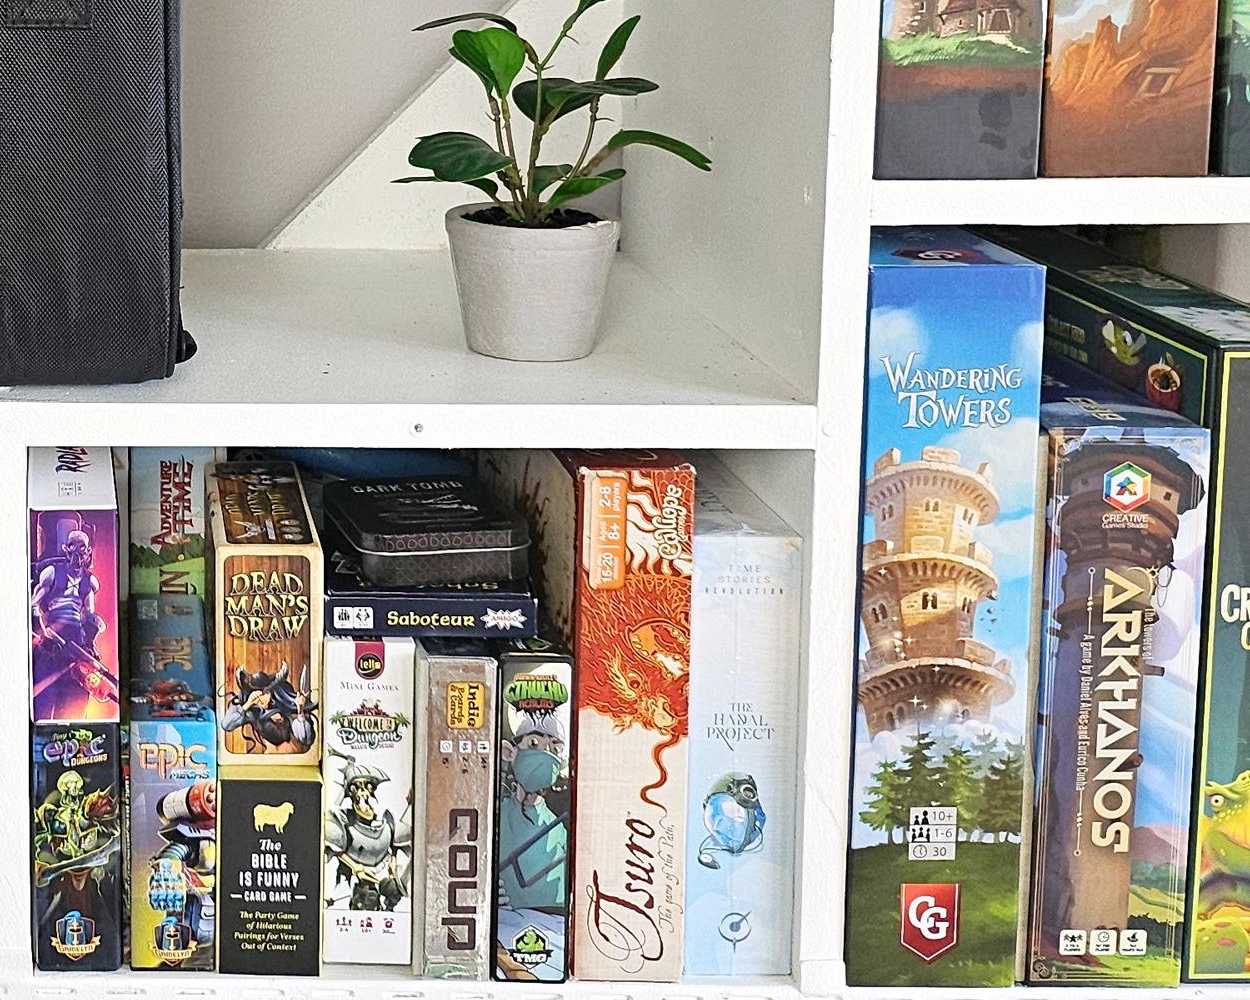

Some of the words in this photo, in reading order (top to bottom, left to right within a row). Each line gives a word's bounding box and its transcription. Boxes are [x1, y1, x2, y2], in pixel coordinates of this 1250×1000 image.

[881, 351, 1022, 394] WANDERING
[897, 390, 1012, 429] TOWERS
[351, 483, 402, 493] DARK
[406, 481, 463, 490] TOMB
[151, 460, 173, 550] ADVENTURE
[172, 460, 194, 533] TIME
[599, 487, 611, 507] 2-8
[613, 482, 621, 512] players
[651, 485, 682, 560] Calliope
[1102, 513, 1149, 523] CREATIVE
[1102, 521, 1125, 529] Games
[1126, 521, 1148, 529] Studio
[608, 523, 620, 540] 8+
[229, 571, 303, 596] DEAD
[718, 576, 771, 584] STORIES
[225, 594, 308, 618] MAN'S
[229, 614, 308, 642] DRAW
[387, 610, 475, 630] Saboteur
[1080, 642, 1092, 663] game
[1079, 665, 1093, 676] by
[367, 682, 398, 691] GAMES
[508, 680, 565, 701] CTHULHU
[1080, 677, 1093, 701] Daniel
[468, 684, 479, 727] Indie
[730, 703, 753, 712] THE
[1078, 702, 1092, 723] Alves
[1091, 567, 1145, 853] ARKHANOS
[337, 728, 402, 749] Dungeon
[707, 727, 774, 751] PROJECT
[71, 754, 108, 767] DUNGEONS
[932, 811, 953, 822] 10+
[934, 828, 952, 839] 1-6
[259, 839, 281, 851] The
[932, 846, 947, 857] 30
[251, 854, 287, 869] BIBLE
[239, 871, 252, 887] IS
[257, 872, 299, 888] FUNNY
[244, 891, 266, 902] CARD
[269, 891, 291, 902] GAME
[586, 818, 663, 973] Tsuro
[239, 911, 253, 919] The
[255, 911, 275, 920] Party
[277, 912, 299, 920] Game
[256, 922, 291, 930] Hilarious
[234, 932, 265, 941] Pairings
[266, 932, 278, 941] for
[280, 932, 304, 940] Verses
[241, 942, 255, 950] Out
[257, 942, 265, 951] of
[267, 942, 296, 951] Context
[514, 953, 547, 963] TMG
